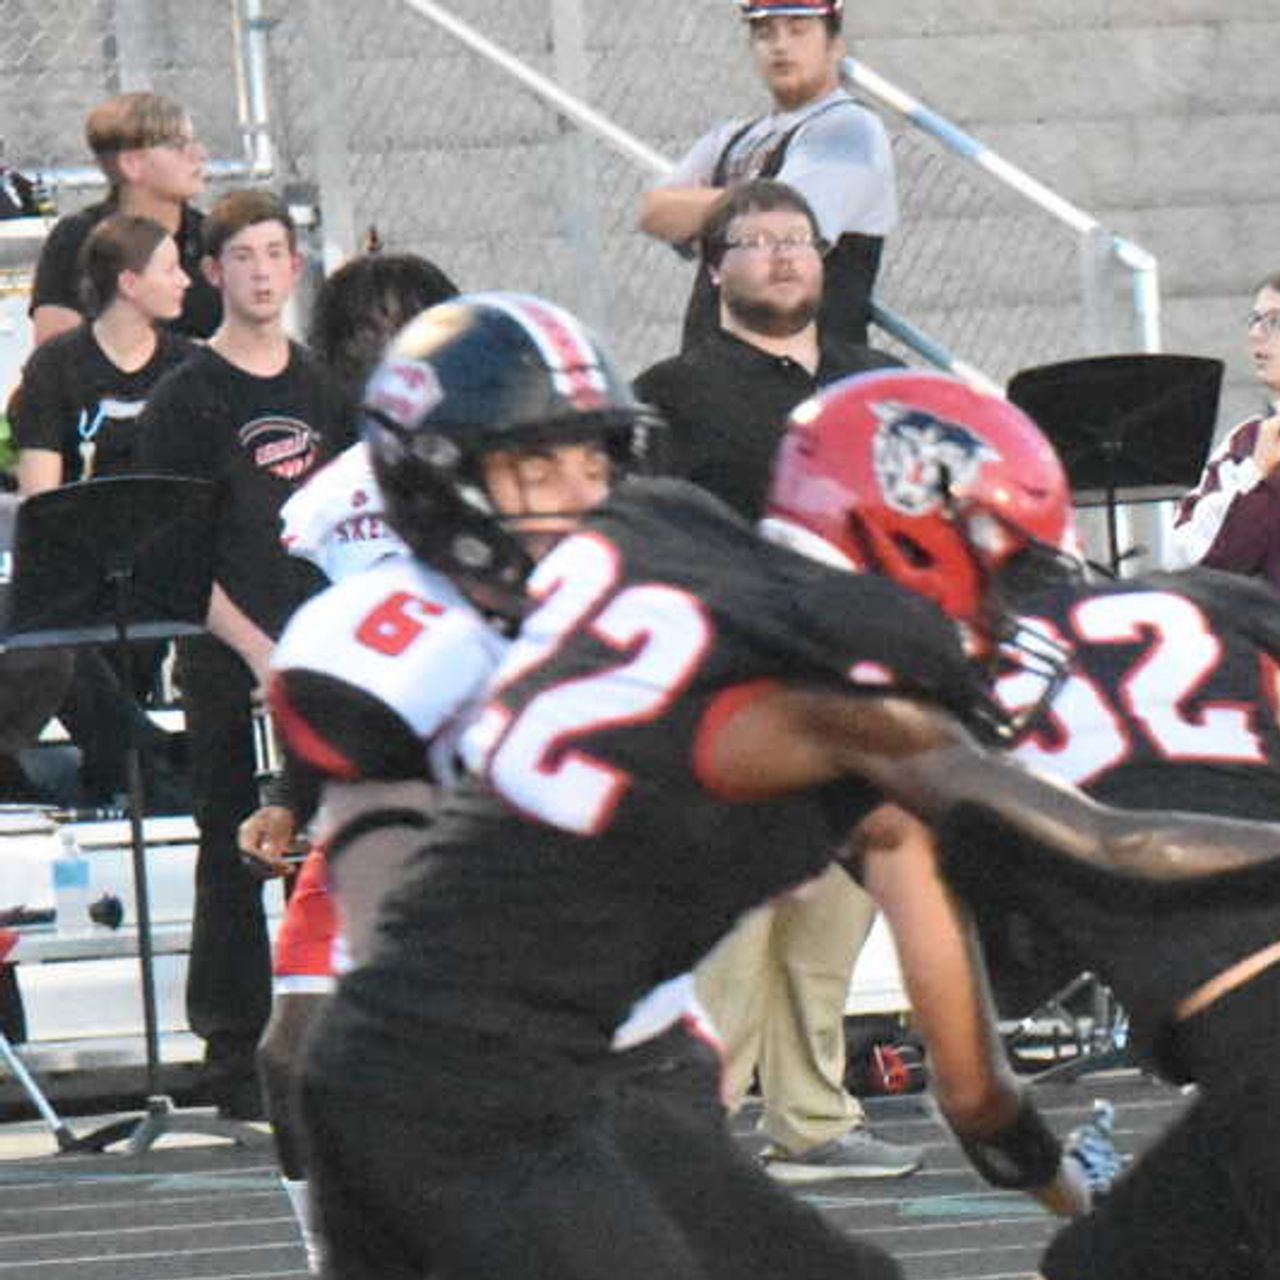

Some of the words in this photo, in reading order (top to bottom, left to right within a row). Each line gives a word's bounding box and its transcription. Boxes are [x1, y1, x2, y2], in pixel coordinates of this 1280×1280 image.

[354, 591, 446, 656] 6
[460, 531, 712, 837] 22
[994, 589, 1269, 791] 32
